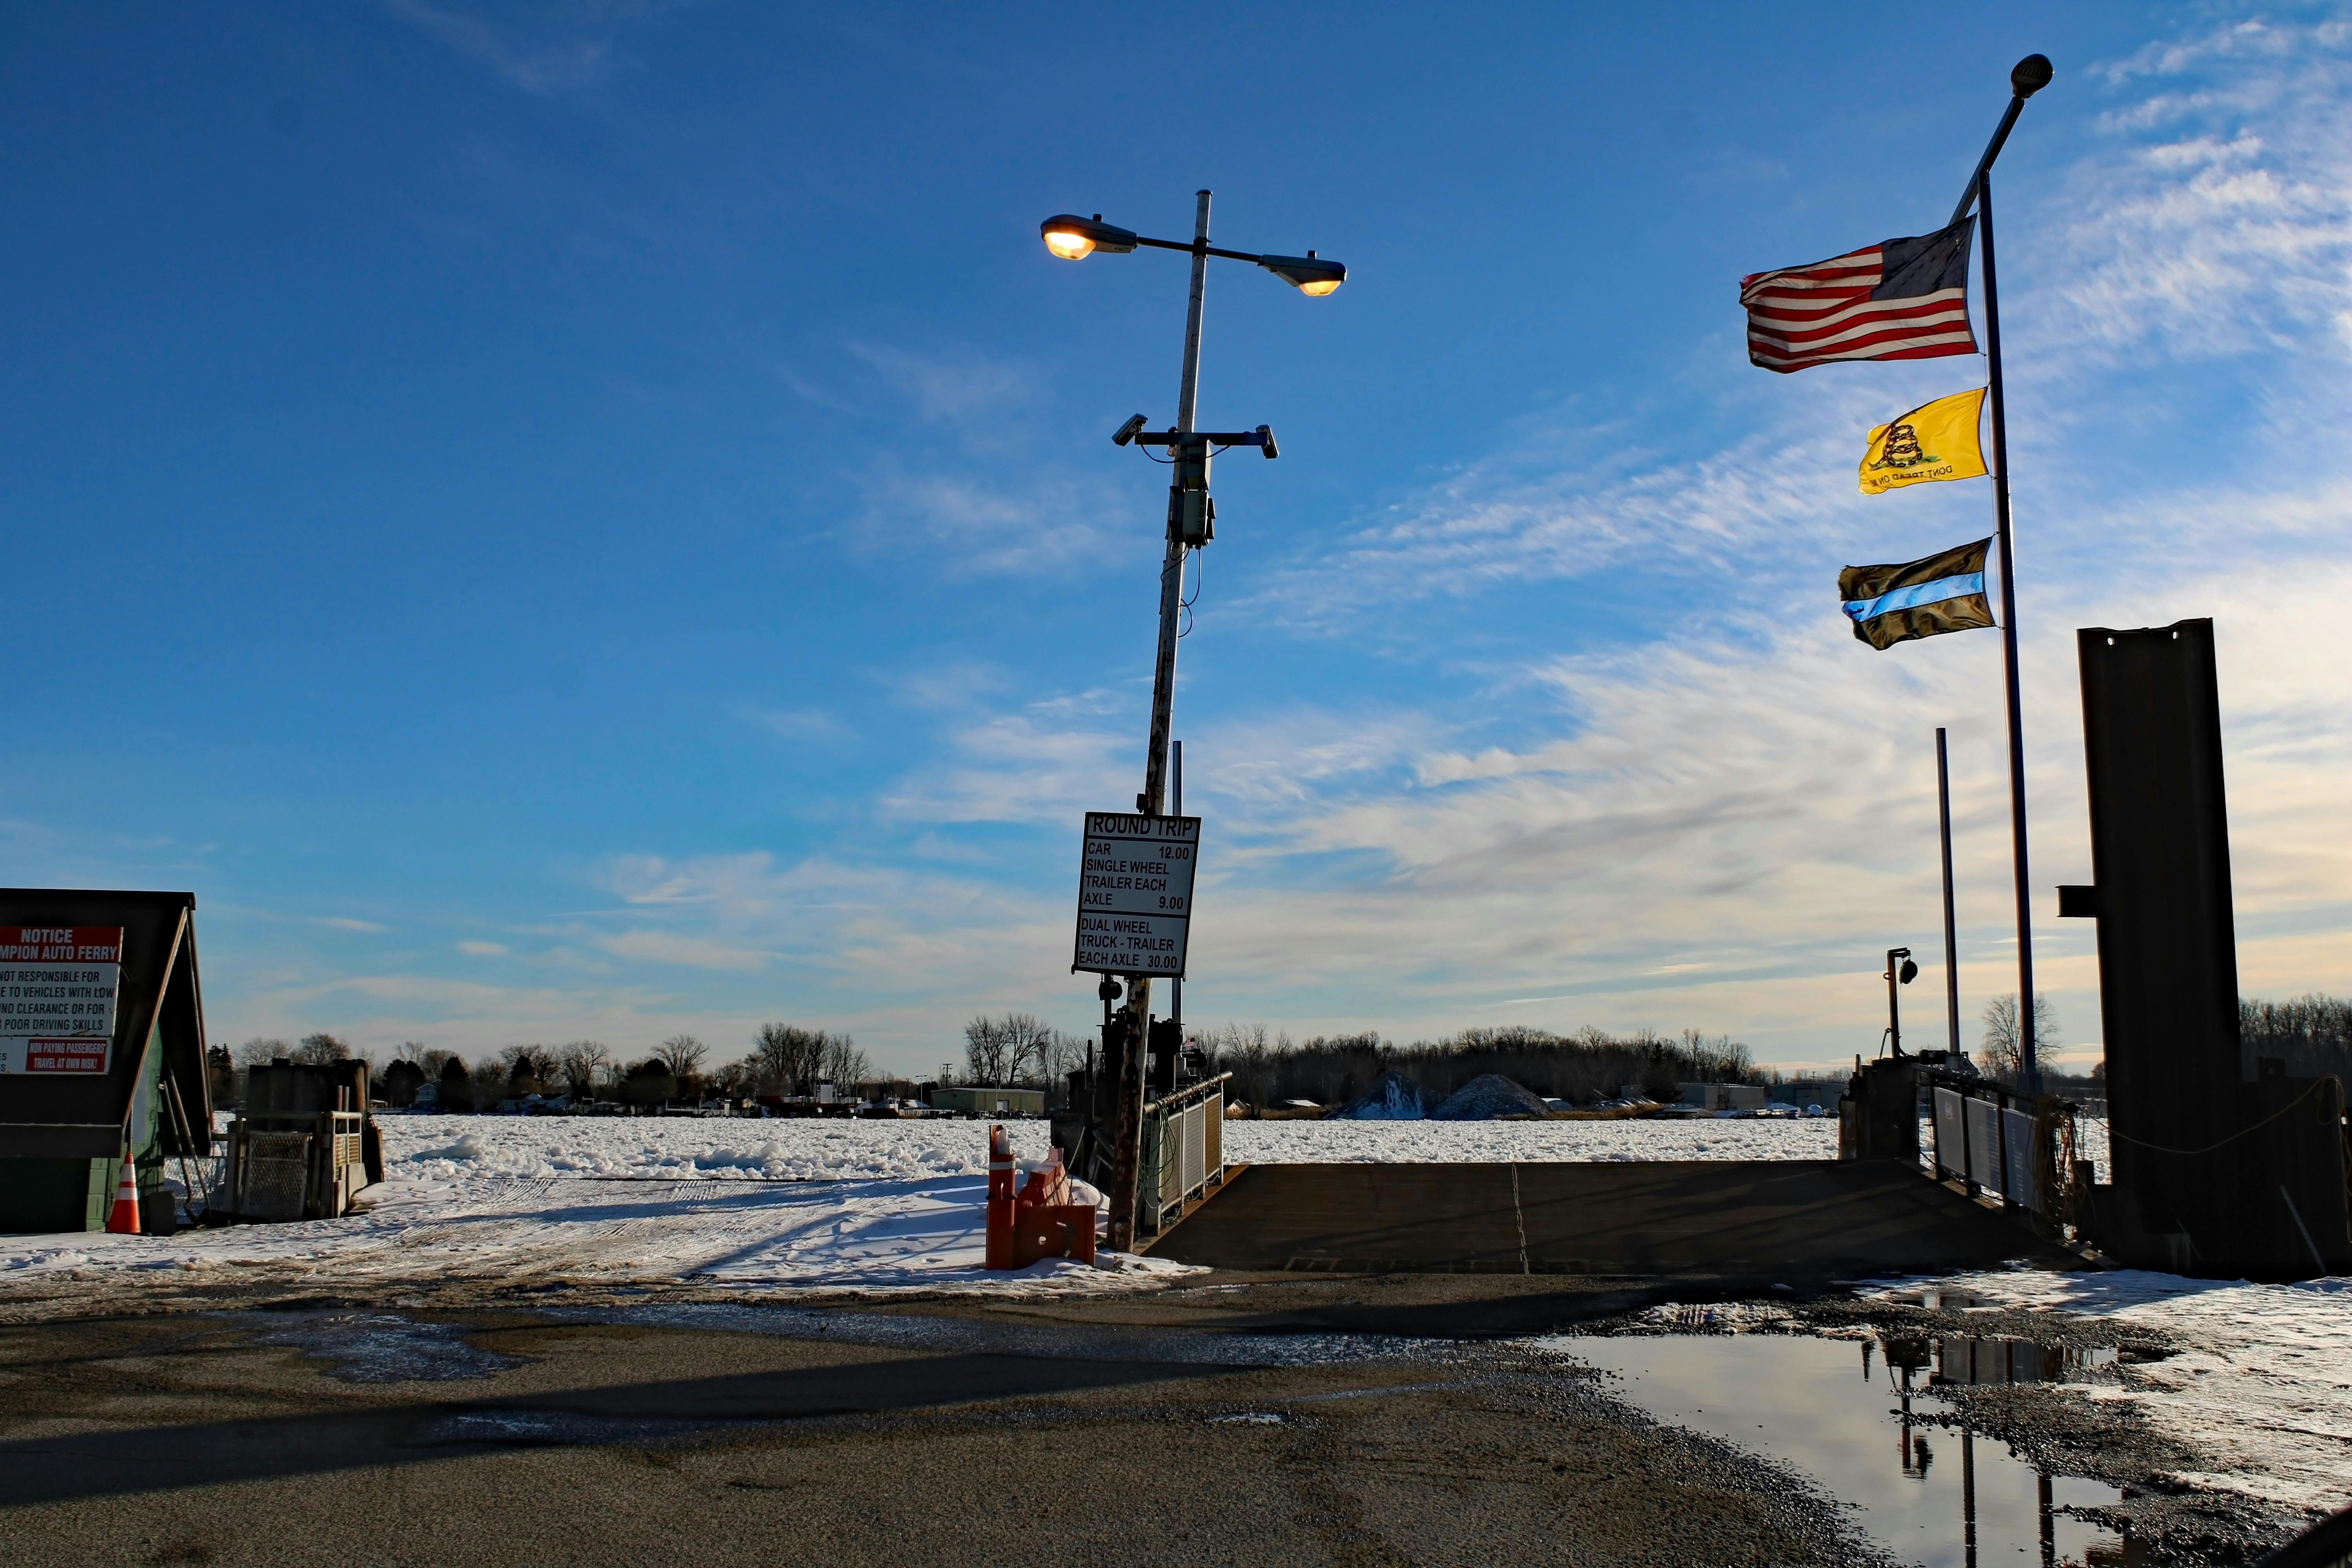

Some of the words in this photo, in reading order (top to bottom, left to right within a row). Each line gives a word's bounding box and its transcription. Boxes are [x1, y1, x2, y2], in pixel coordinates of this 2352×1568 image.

[1093, 816, 1151, 835] ROUND
[1156, 819, 1193, 837] TRIP
[1088, 842, 1111, 855] CAR
[1159, 846, 1189, 860] 12.00
[1086, 858, 1127, 873] SINGLE
[1130, 861, 1169, 875] WHEEL
[1085, 875, 1132, 890] TRAILER
[1135, 878, 1166, 891] EACH
[1083, 892, 1112, 906] AXLE
[1159, 896, 1183, 910] 9.00
[1082, 918, 1110, 931] DUAL
[1113, 920, 1152, 934] WHEEL
[21, 929, 73, 943] NOTICE
[1080, 935, 1118, 948] TRUCK
[1127, 937, 1174, 951] TRAILER
[42, 946, 74, 960] AUTO
[78, 946, 118, 960] FERRY
[1079, 951, 1108, 964] EACH
[1111, 953, 1140, 966] AXLE
[1148, 955, 1176, 969] 30.00
[18, 971, 79, 982] RESPONSIBLE
[82, 971, 99, 982] FOR
[9, 987, 20, 997] TO
[24, 987, 65, 998] VEHICLES
[69, 987, 91, 998] WITH
[94, 987, 114, 998] LOW
[0, 1003, 13, 1014] ND
[17, 1004, 68, 1014] CLEARANCE
[72, 1004, 83, 1014] OR
[87, 1004, 104, 1014] FOR
[5, 1019, 29, 1029] POOR
[33, 1019, 69, 1030] DRIVING
[73, 1020, 103, 1030] SKILLS
[29, 1042, 42, 1053] NON
[44, 1043, 65, 1053] PAYING
[67, 1043, 104, 1054] PASSENGERS
[34, 1058, 55, 1068] TRAVEL
[57, 1058, 65, 1068] AT
[66, 1058, 80, 1069] OWN
[81, 1058, 97, 1069] RISK!
